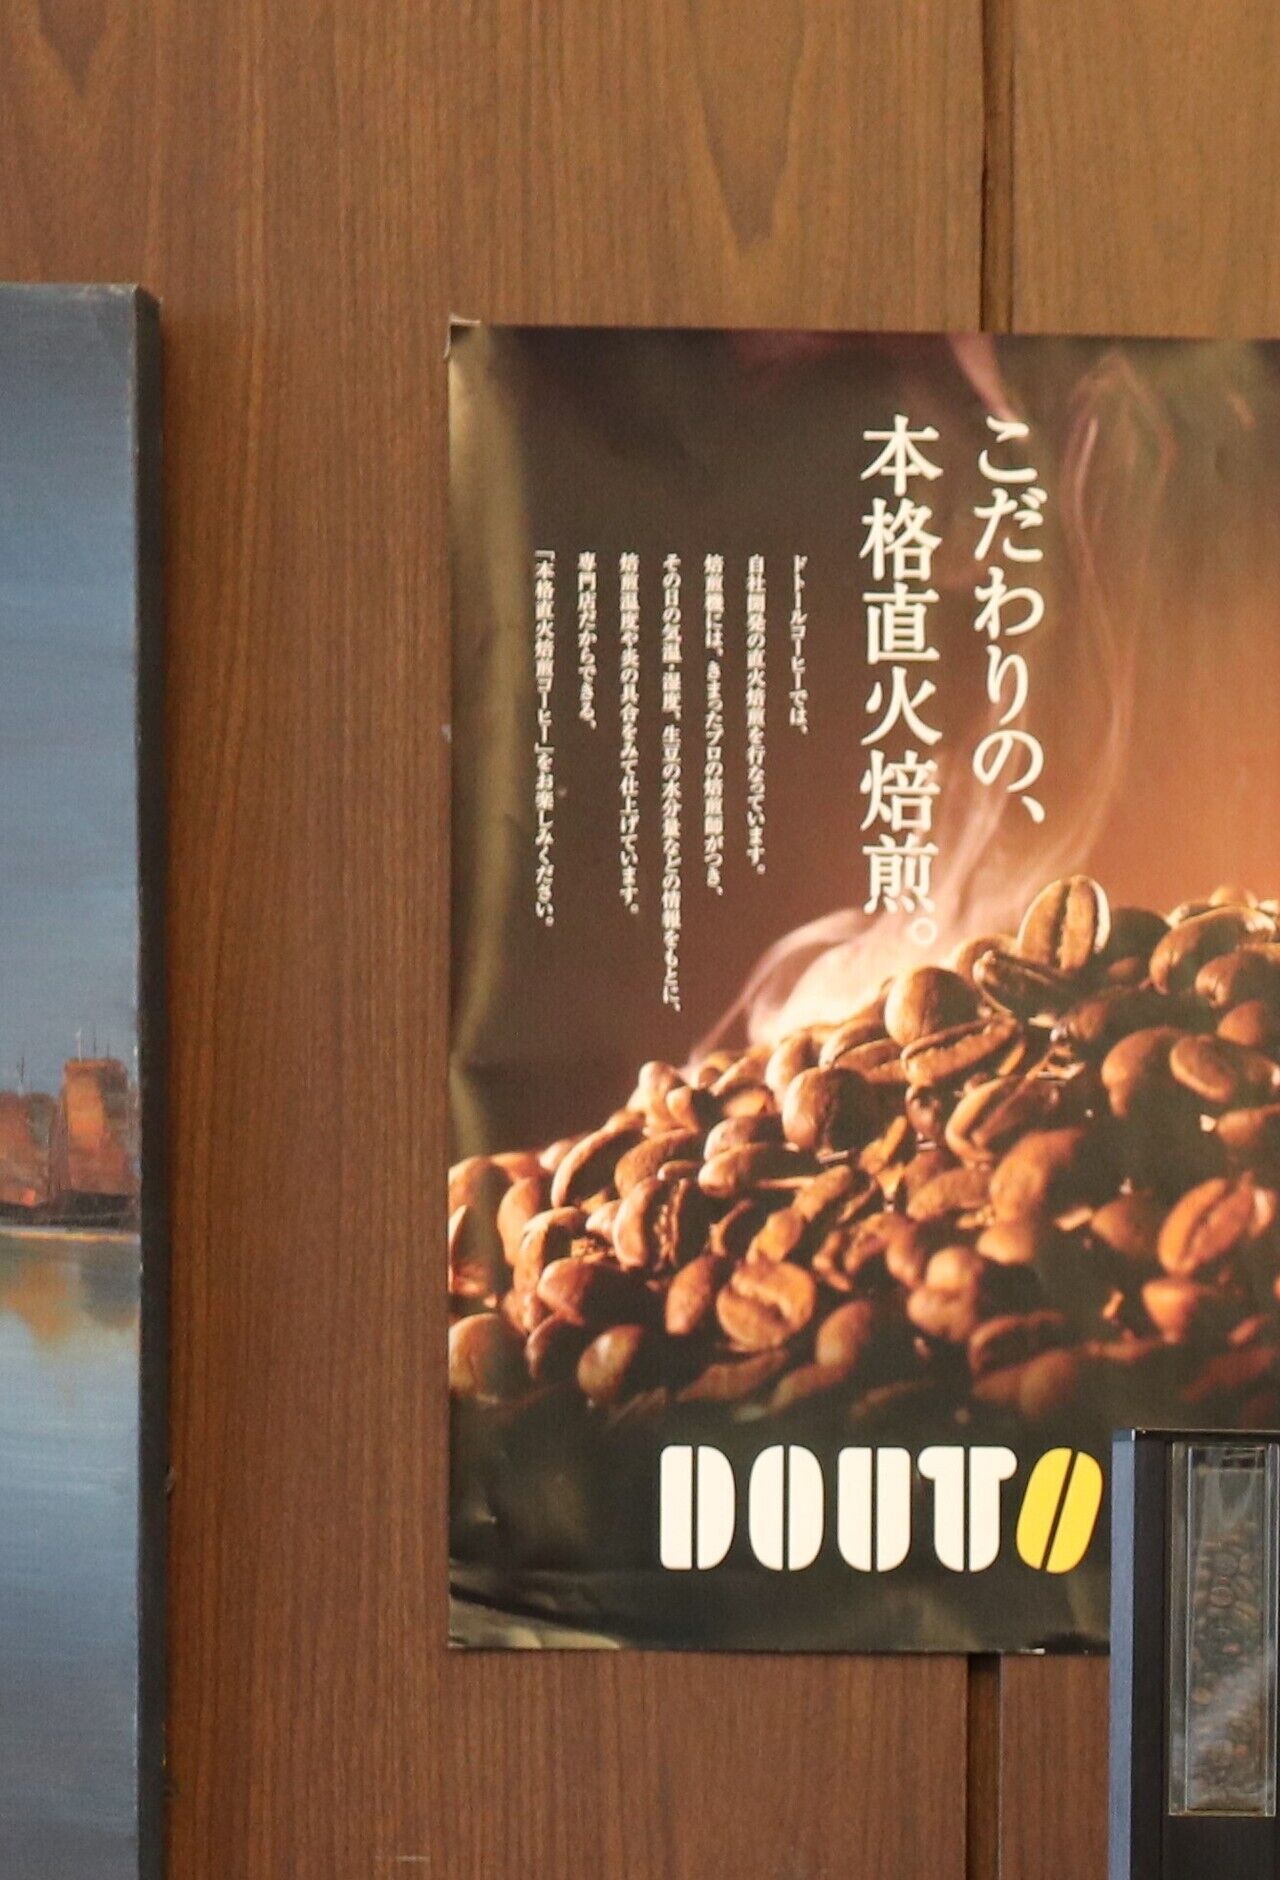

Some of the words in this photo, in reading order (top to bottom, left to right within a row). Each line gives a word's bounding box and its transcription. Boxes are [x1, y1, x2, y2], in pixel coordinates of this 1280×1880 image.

[789, 554, 808, 735] ドトールコーヒーでは、
[858, 414, 943, 947] 本格直火焙煎。
[973, 416, 1047, 823] こだわりの、
